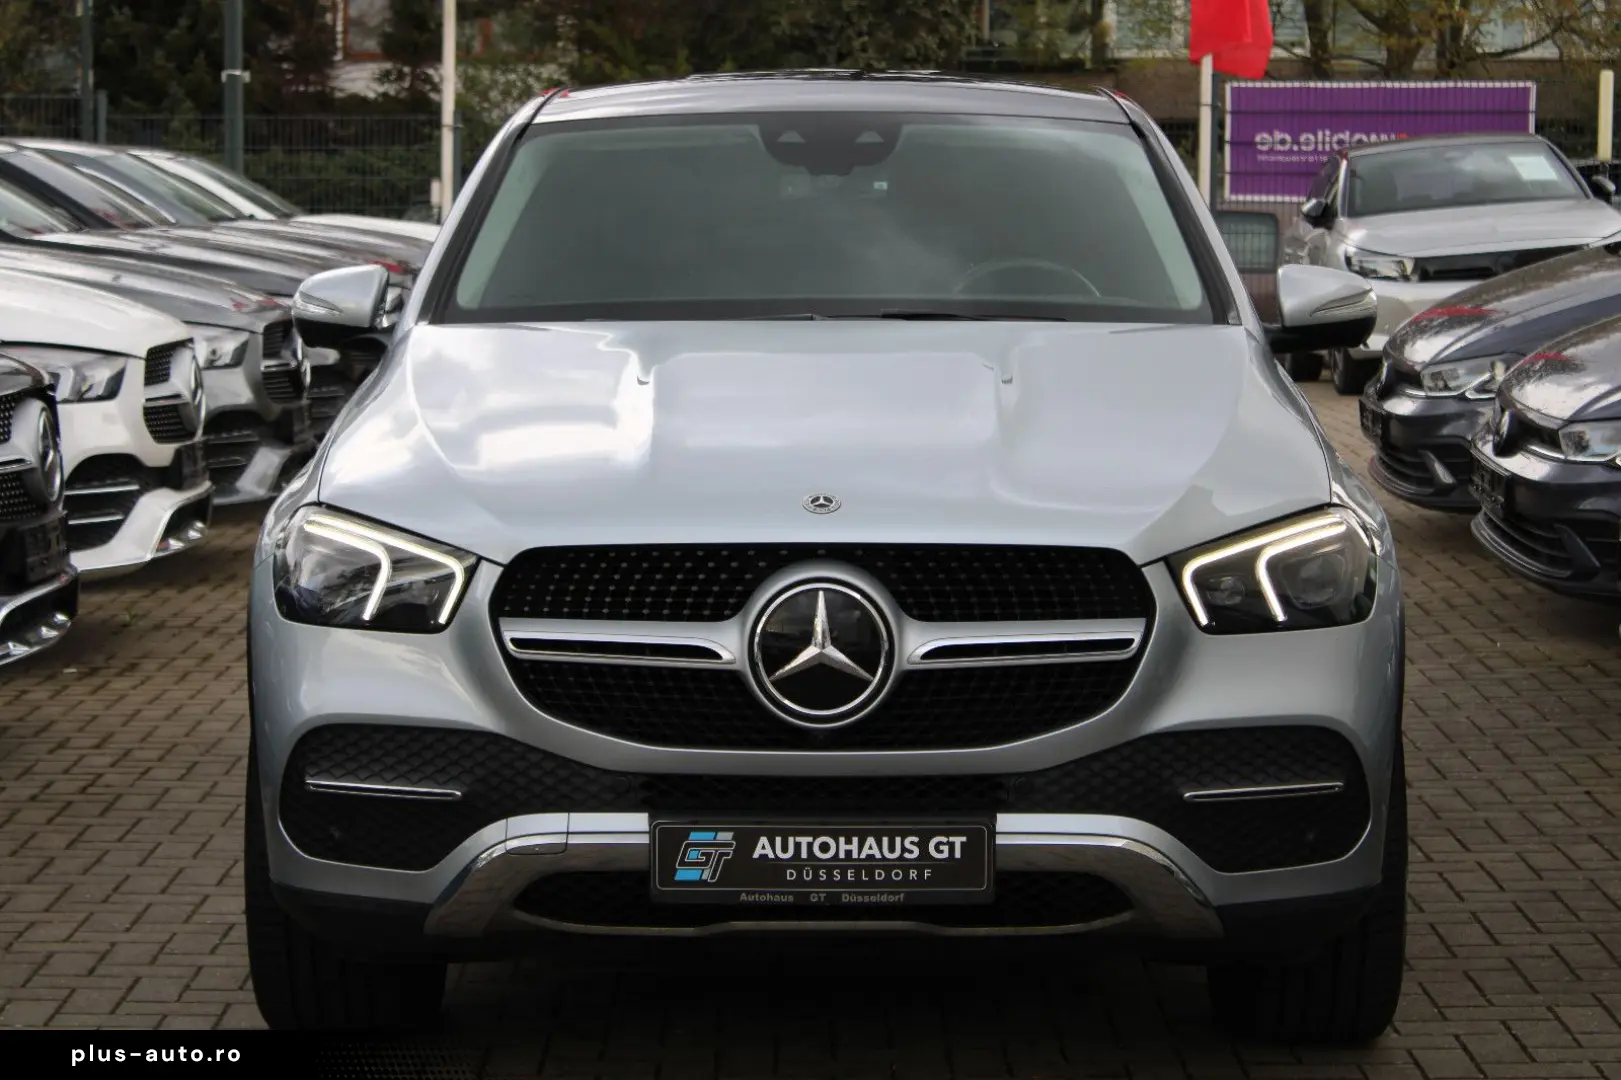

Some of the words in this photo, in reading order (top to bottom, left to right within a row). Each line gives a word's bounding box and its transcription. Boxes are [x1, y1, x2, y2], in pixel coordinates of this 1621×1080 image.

[753, 836, 917, 858] AUTOHAUS
[928, 836, 967, 858] GT
[786, 867, 932, 880] DÜSSELDORF
[740, 891, 794, 902] Autohaus
[809, 891, 827, 902] GT
[841, 890, 904, 902] Düsseldorf
